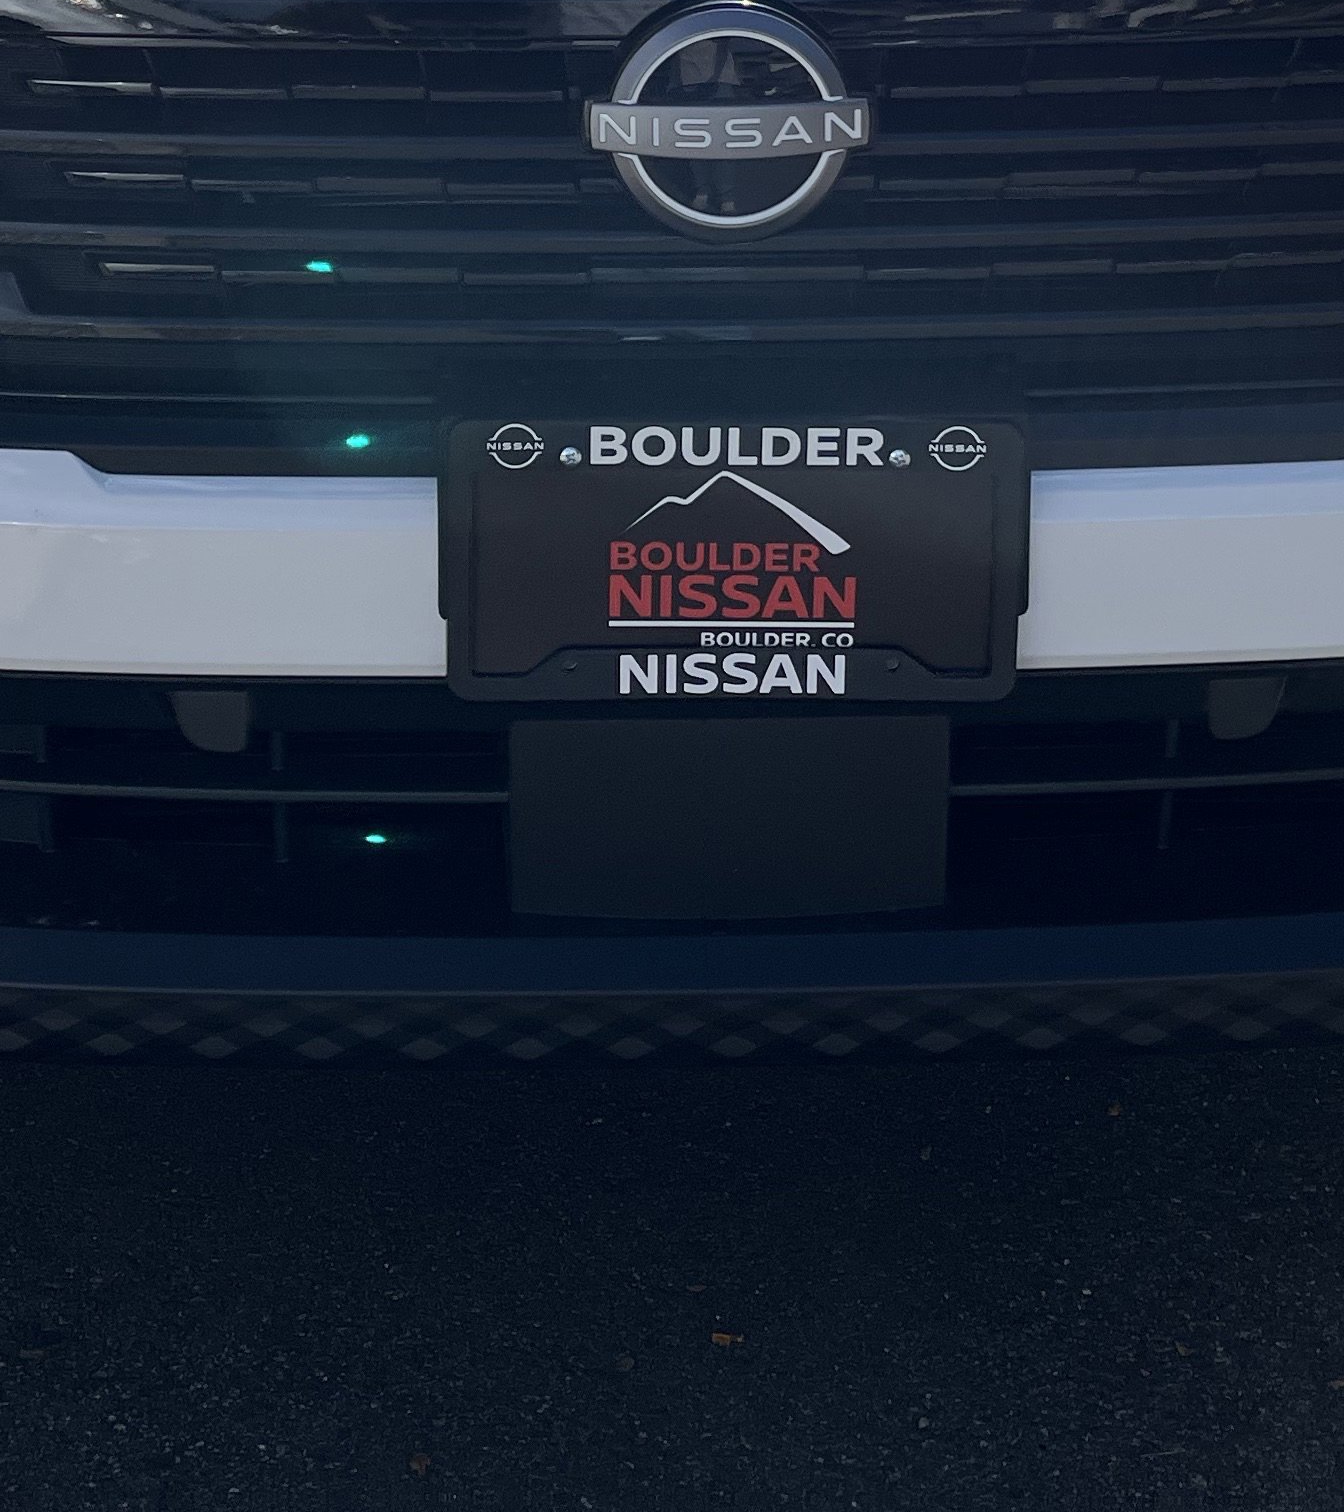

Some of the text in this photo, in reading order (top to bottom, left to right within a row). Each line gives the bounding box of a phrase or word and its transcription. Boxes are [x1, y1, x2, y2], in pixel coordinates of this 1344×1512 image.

[599, 109, 862, 149] NISSAN
[486, 441, 545, 451] NISSAN
[589, 425, 885, 467] BOULDER
[928, 443, 987, 454] NISSAN
[609, 540, 821, 573] BOULDER
[608, 573, 857, 619] NISSAN
[821, 632, 855, 648] CO
[618, 652, 846, 695] NISSAN
